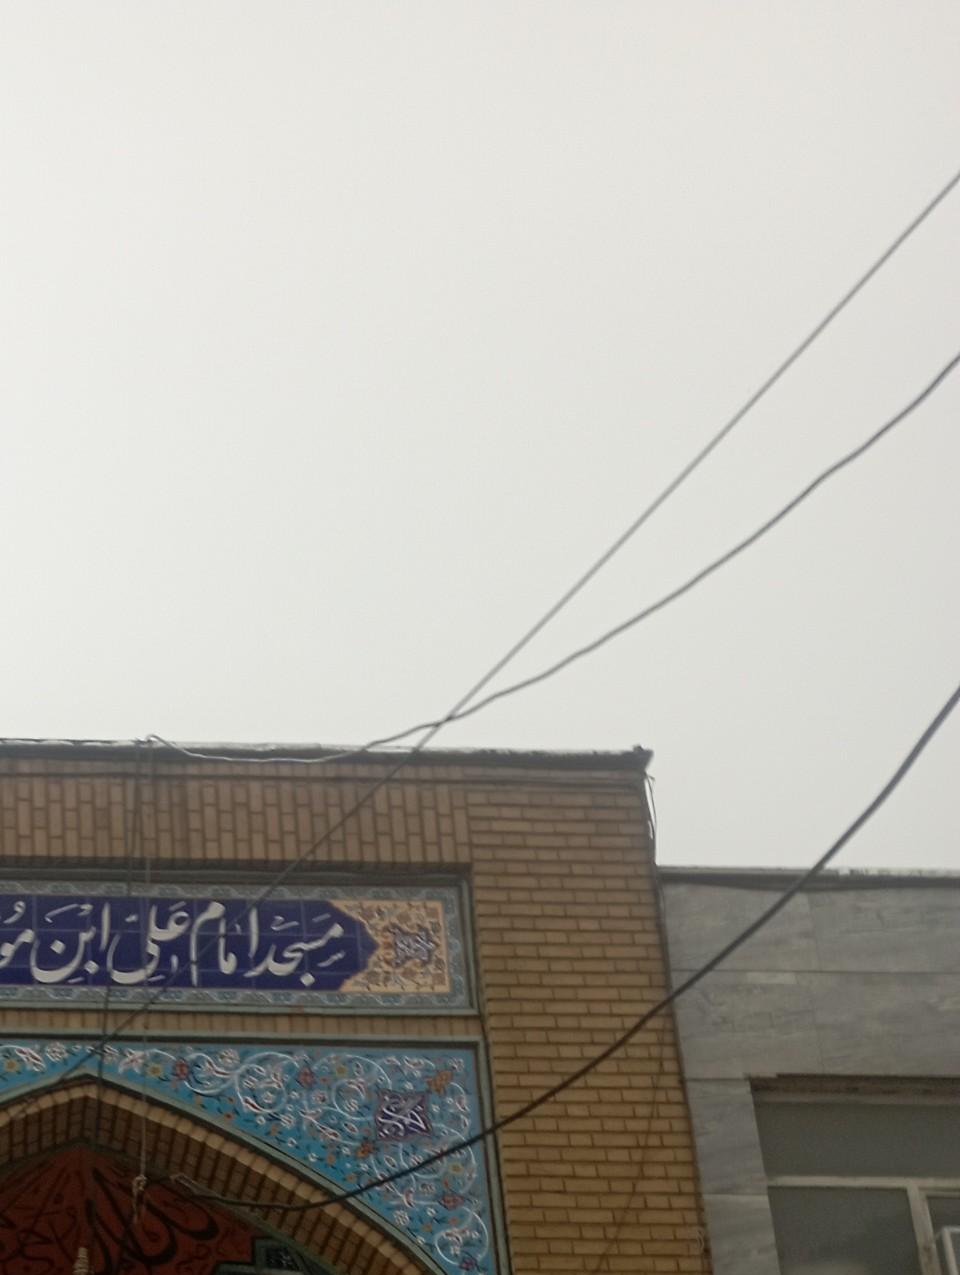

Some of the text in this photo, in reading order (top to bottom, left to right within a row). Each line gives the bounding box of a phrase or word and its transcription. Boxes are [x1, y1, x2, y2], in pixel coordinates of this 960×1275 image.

[30, 901, 109, 985] ابن
[106, 901, 191, 985] علی
[190, 900, 259, 987] امام
[243, 912, 346, 987] مسجد
